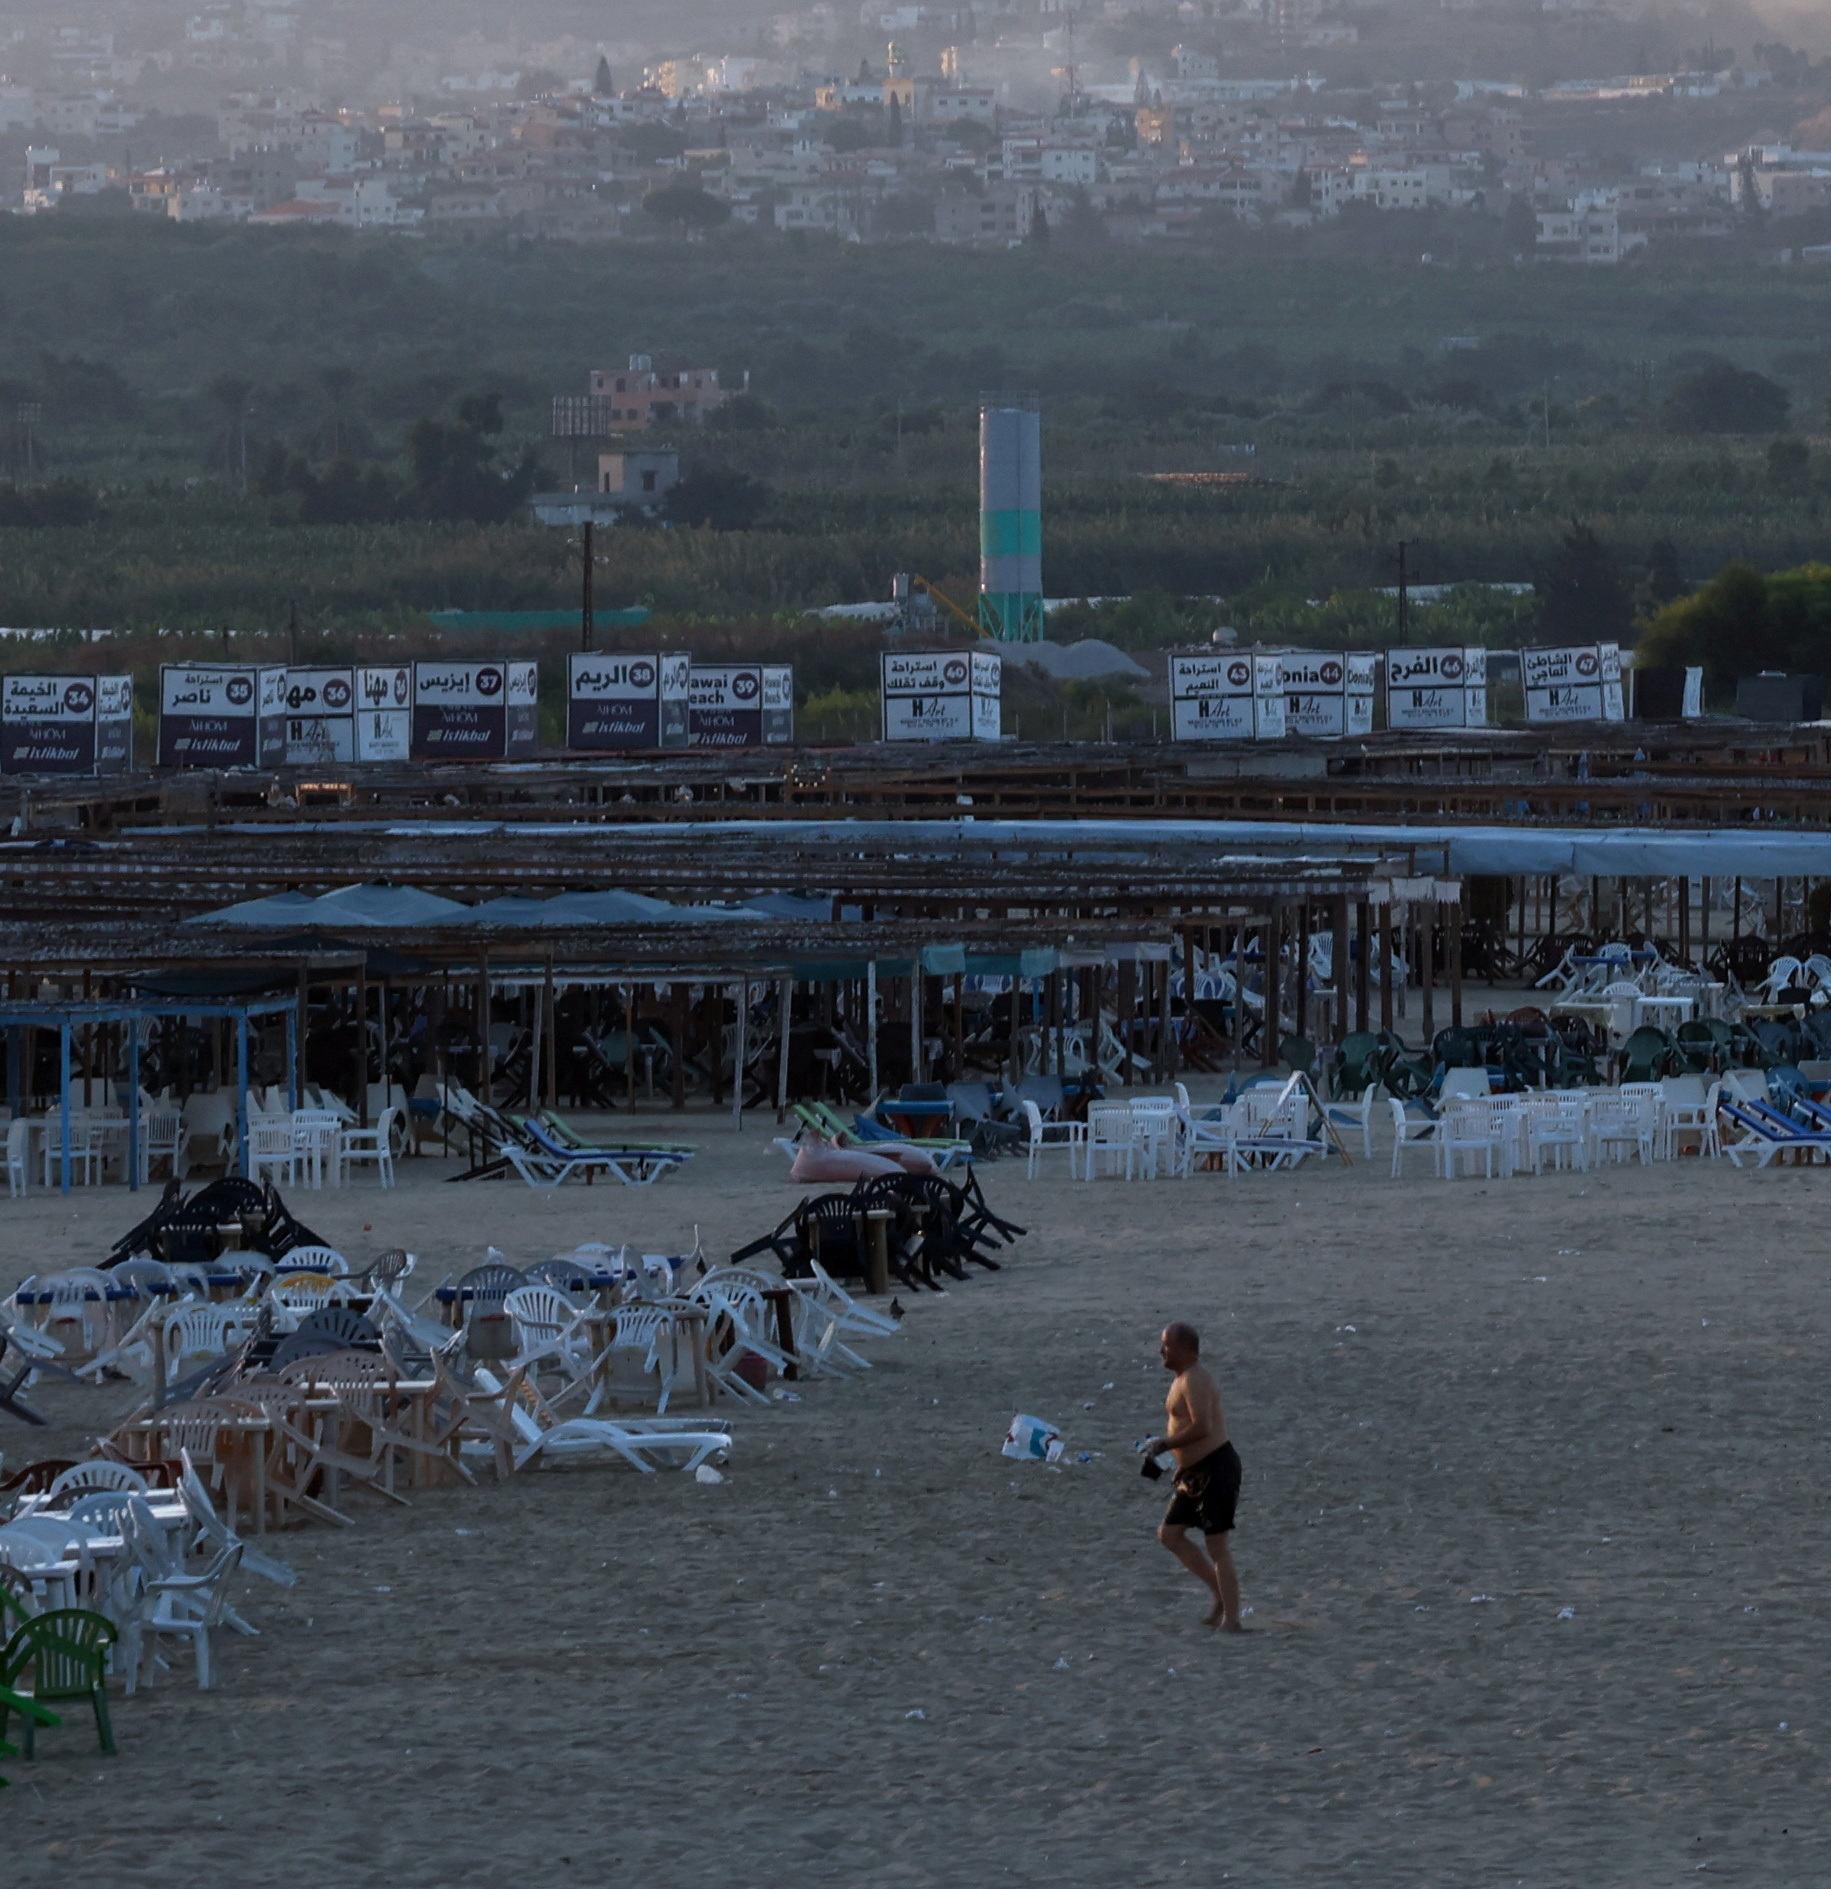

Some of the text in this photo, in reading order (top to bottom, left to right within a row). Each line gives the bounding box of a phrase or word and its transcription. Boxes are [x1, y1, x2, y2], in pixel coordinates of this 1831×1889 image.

[891, 660, 937, 674] استراحة
[1391, 655, 1438, 682] الفرح
[1444, 661, 1460, 673] 46
[1527, 653, 1572, 670] الشاطئ
[1579, 658, 1594, 670] 47
[633, 669, 651, 681] 38
[946, 667, 964, 678] 40
[1179, 663, 1221, 677] استراحة
[1283, 665, 1319, 682] onia
[1323, 667, 1339, 679] 44
[1531, 665, 1568, 687] العاجي
[185, 674, 223, 686] استراحة
[420, 672, 470, 693] إيزيس
[480, 675, 498, 689] 37
[576, 665, 627, 692] الريم
[690, 674, 728, 688] awai
[919, 676, 945, 690] وقف
[10, 680, 57, 701] الخيمة
[230, 684, 249, 698] 35
[327, 686, 347, 701] 36
[365, 670, 388, 706] مهنا
[736, 680, 755, 693] 39
[1186, 678, 1219, 695] النعيم
[68, 690, 89, 706] 34
[172, 689, 211, 707] ناصر
[689, 689, 725, 704] each
[5, 699, 64, 720] السعيدة
[912, 699, 923, 717] H
[1199, 699, 1209, 717] H
[1289, 696, 1300, 714] H
[599, 721, 645, 734] istikbal
[443, 729, 492, 742] istikbal
[701, 733, 748, 745] istikbal
[191, 738, 241, 751] istikbal
[30, 746, 80, 760] istikbal
